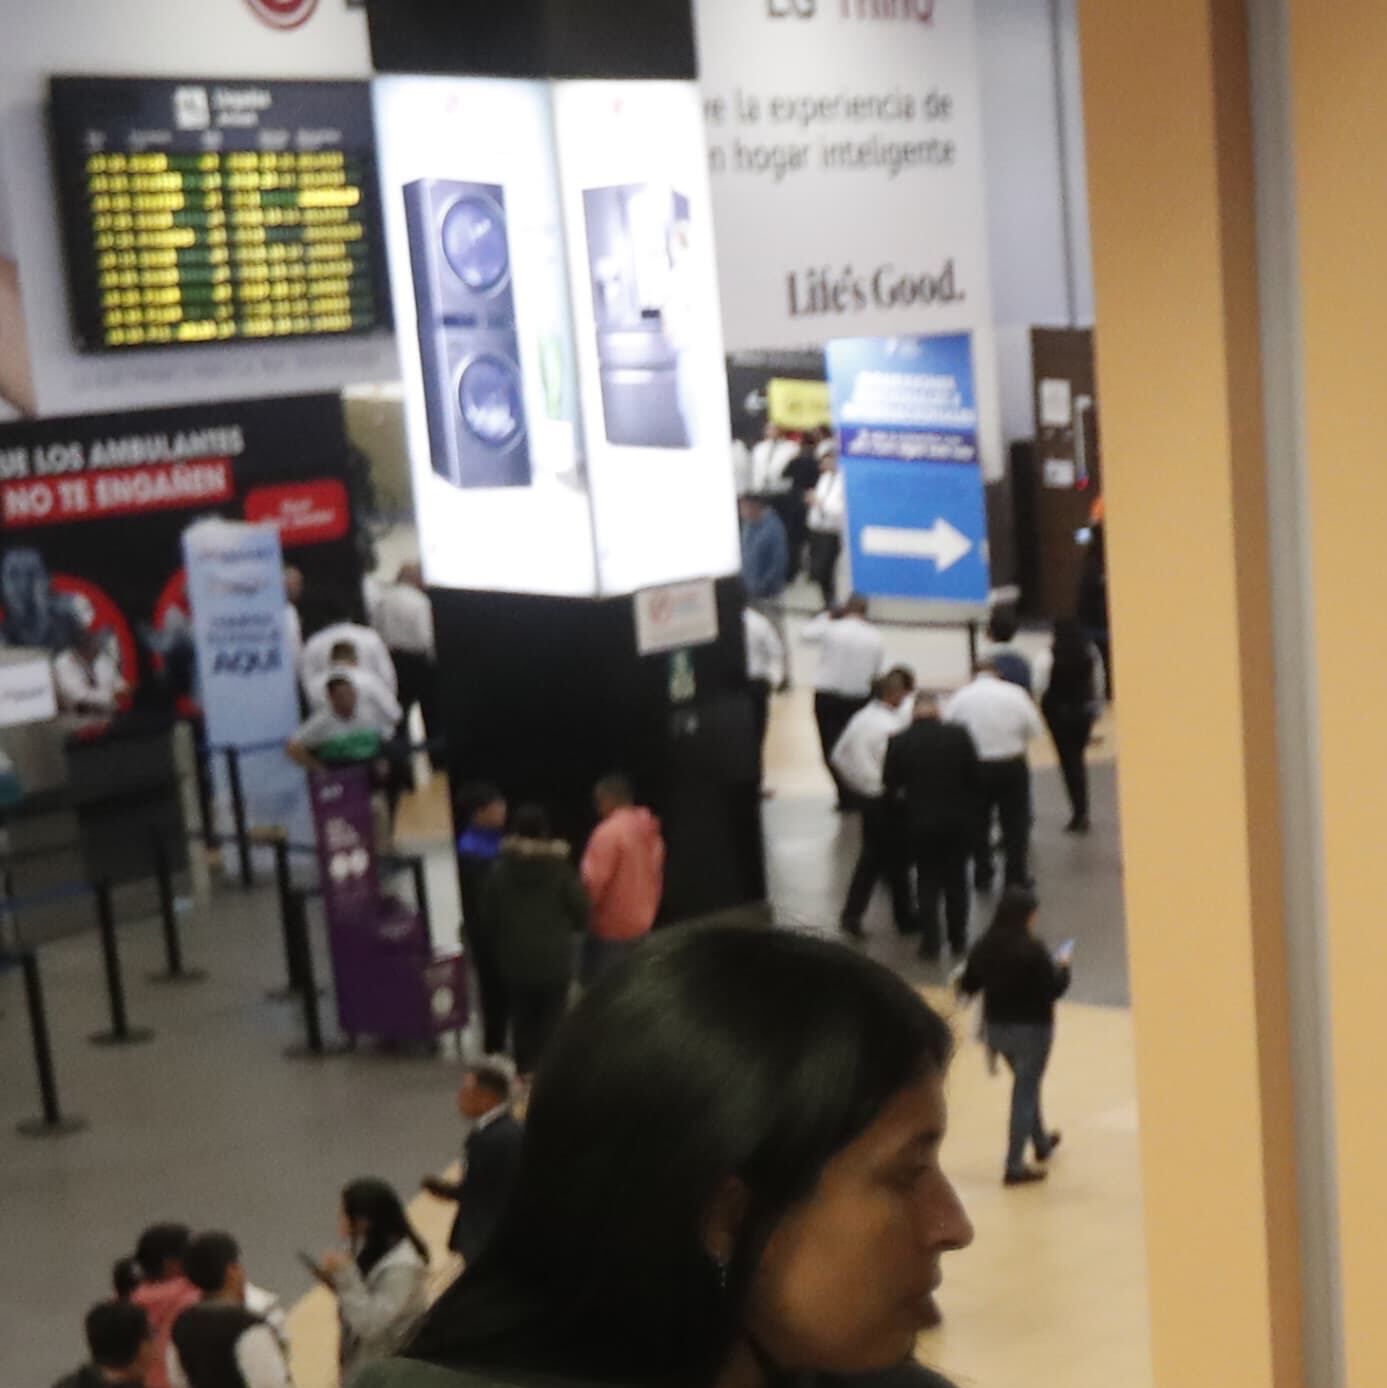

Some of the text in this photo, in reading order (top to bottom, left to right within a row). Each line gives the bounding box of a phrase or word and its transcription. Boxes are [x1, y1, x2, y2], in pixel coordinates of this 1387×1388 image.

[735, 86, 760, 122] la
[768, 90, 915, 128] experiencia
[924, 86, 953, 121] de
[733, 137, 809, 182] hogar
[821, 133, 956, 182] inteligente
[33, 441, 85, 474] LOS
[90, 424, 244, 469] AMBULANTES
[4, 461, 228, 520] NO TE ENGAÑEN
